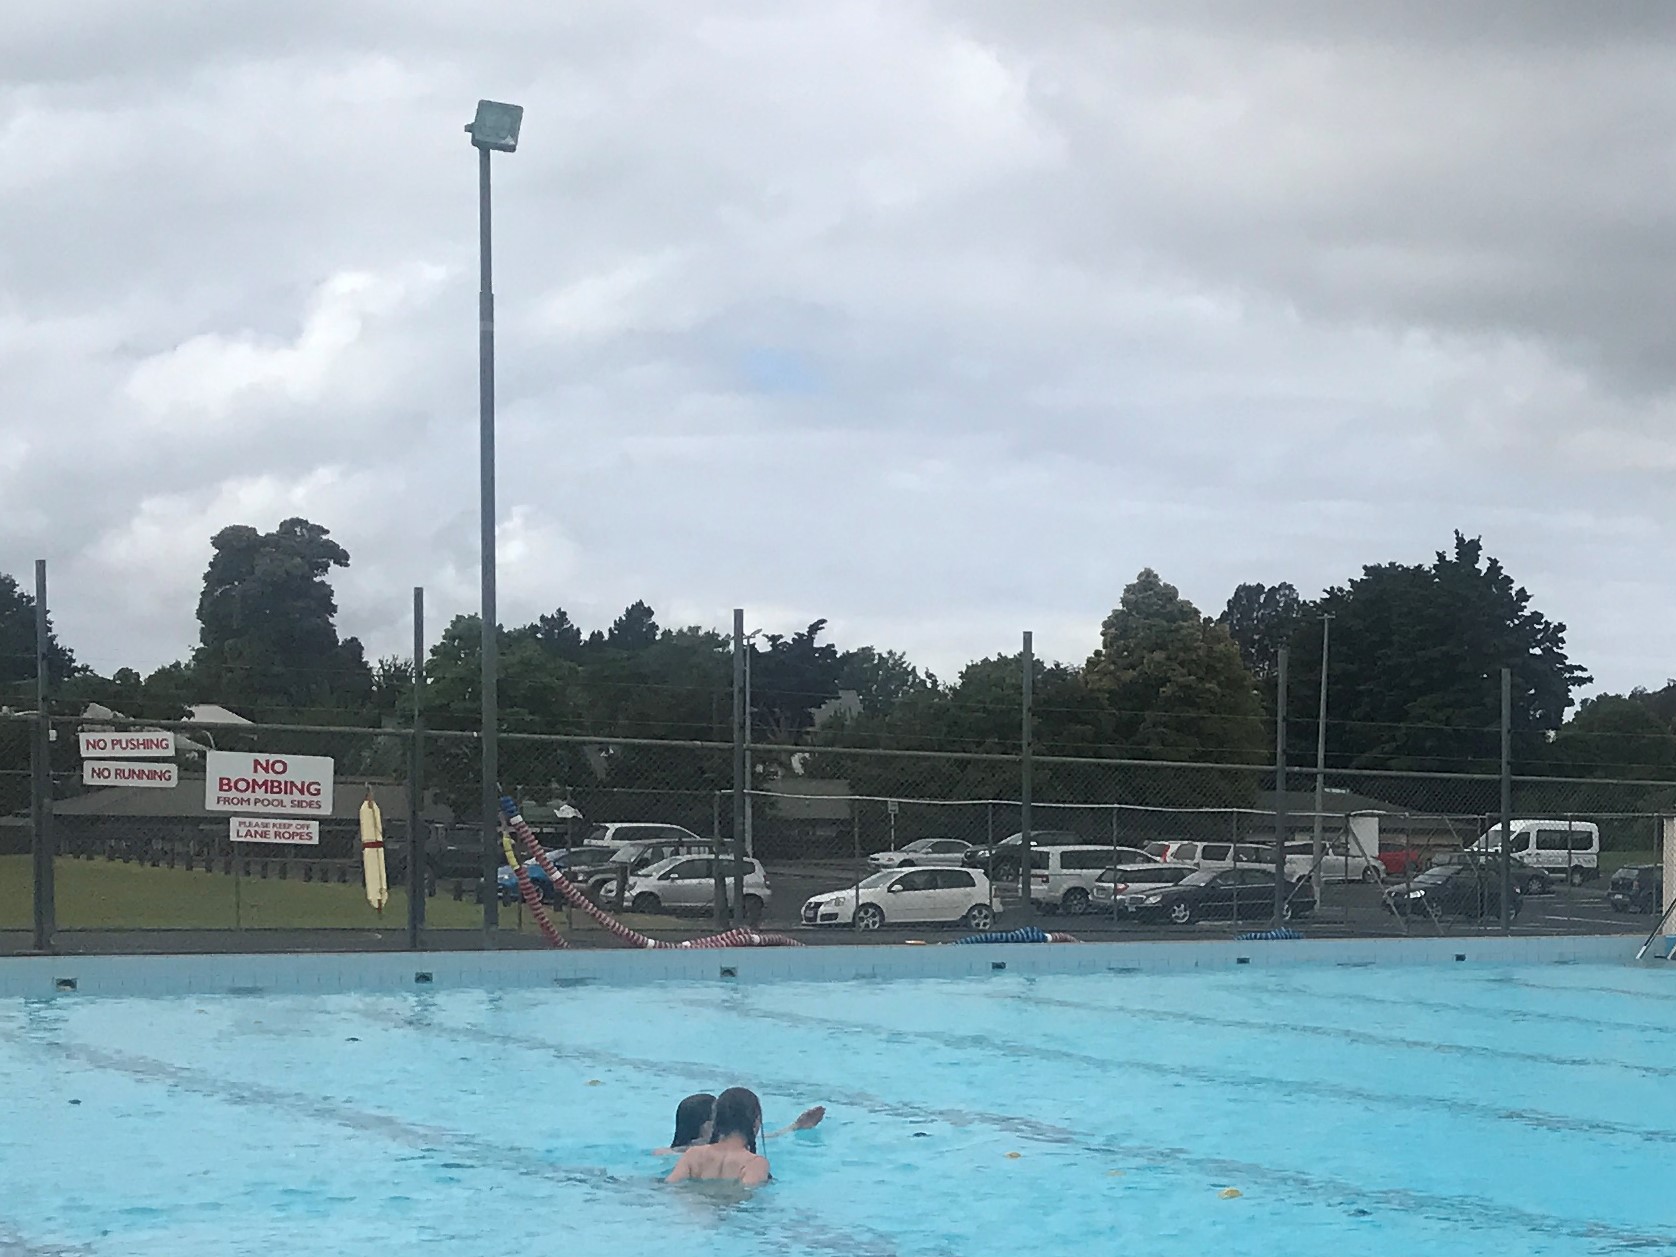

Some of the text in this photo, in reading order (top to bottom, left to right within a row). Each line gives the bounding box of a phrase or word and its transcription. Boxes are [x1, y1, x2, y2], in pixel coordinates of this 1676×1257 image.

[86, 738, 169, 751] NO PUSHING
[253, 759, 288, 775] NO
[91, 767, 171, 782] NO RUNNING
[218, 776, 321, 797] BOMBING
[216, 796, 322, 810] FROM POOL SIDES
[238, 821, 311, 831] PLEASE KEEP OFF
[236, 829, 313, 841] LANE ROPES
